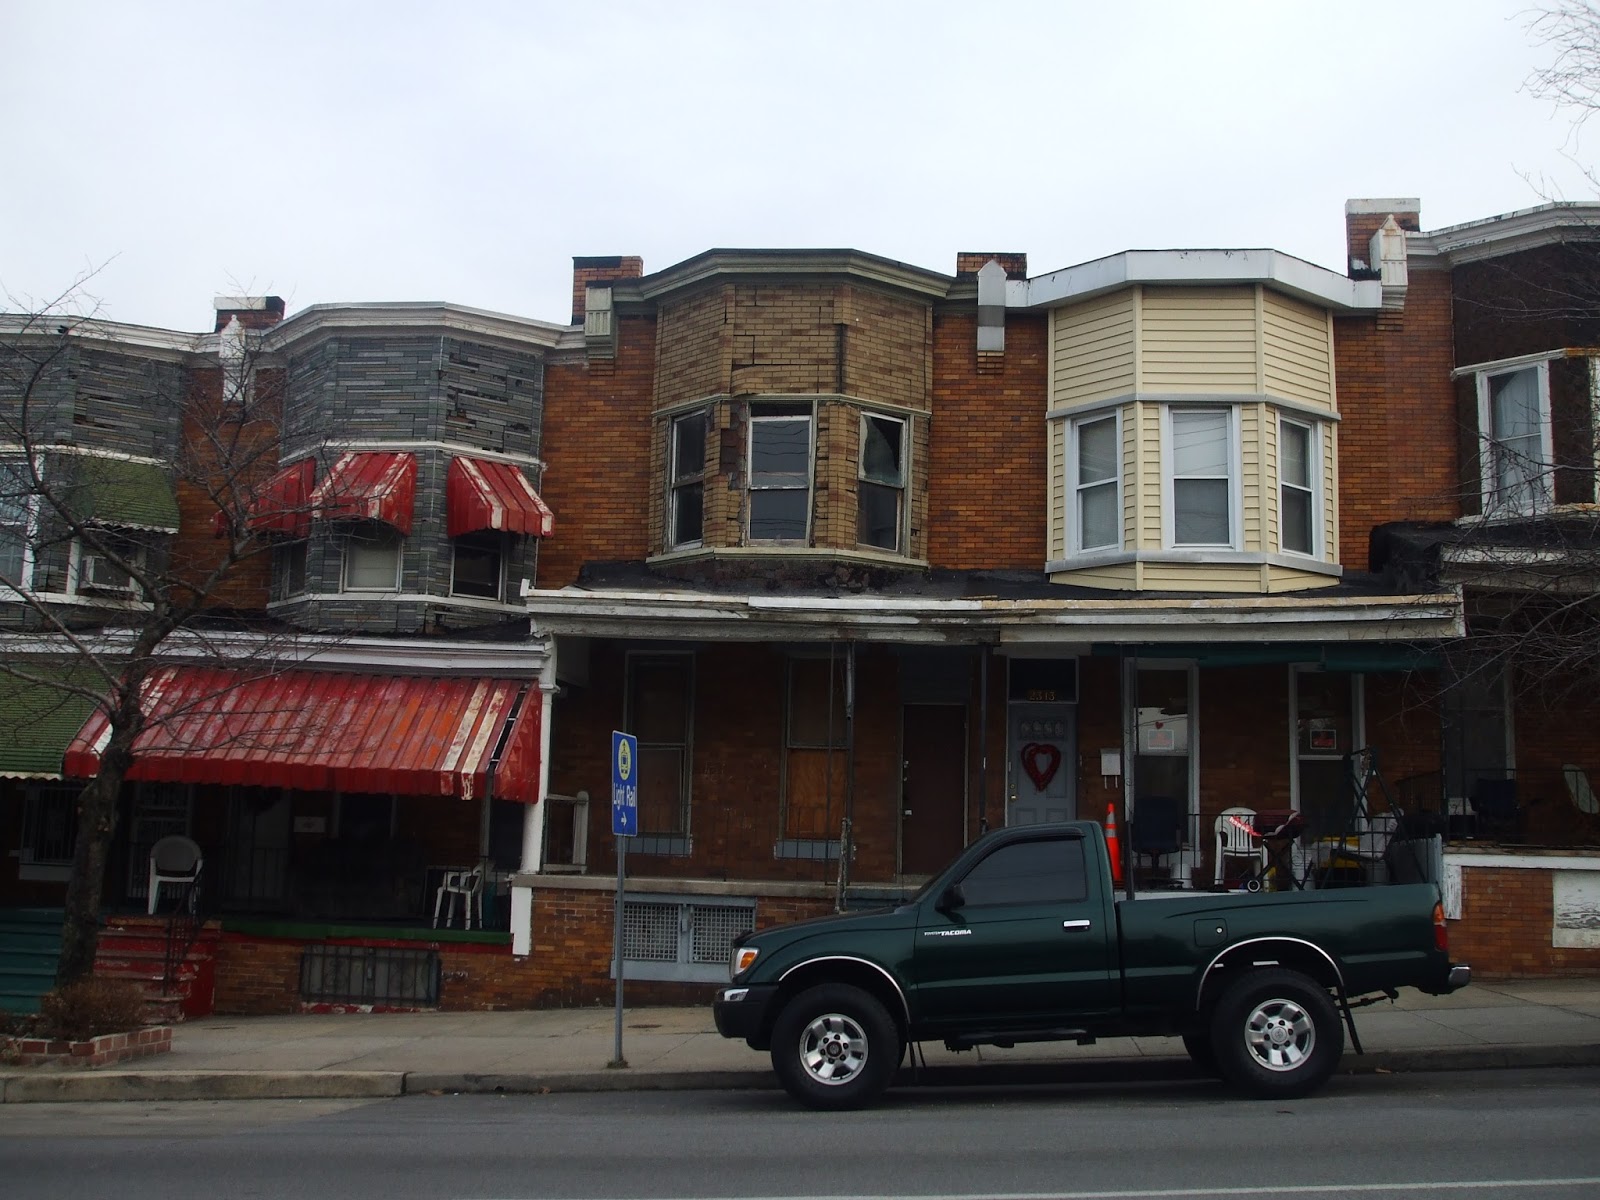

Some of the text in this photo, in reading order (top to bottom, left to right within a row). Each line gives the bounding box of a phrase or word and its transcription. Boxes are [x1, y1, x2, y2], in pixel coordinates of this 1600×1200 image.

[613, 783, 636, 811] Light Rail
[941, 929, 972, 937] TACOMA
